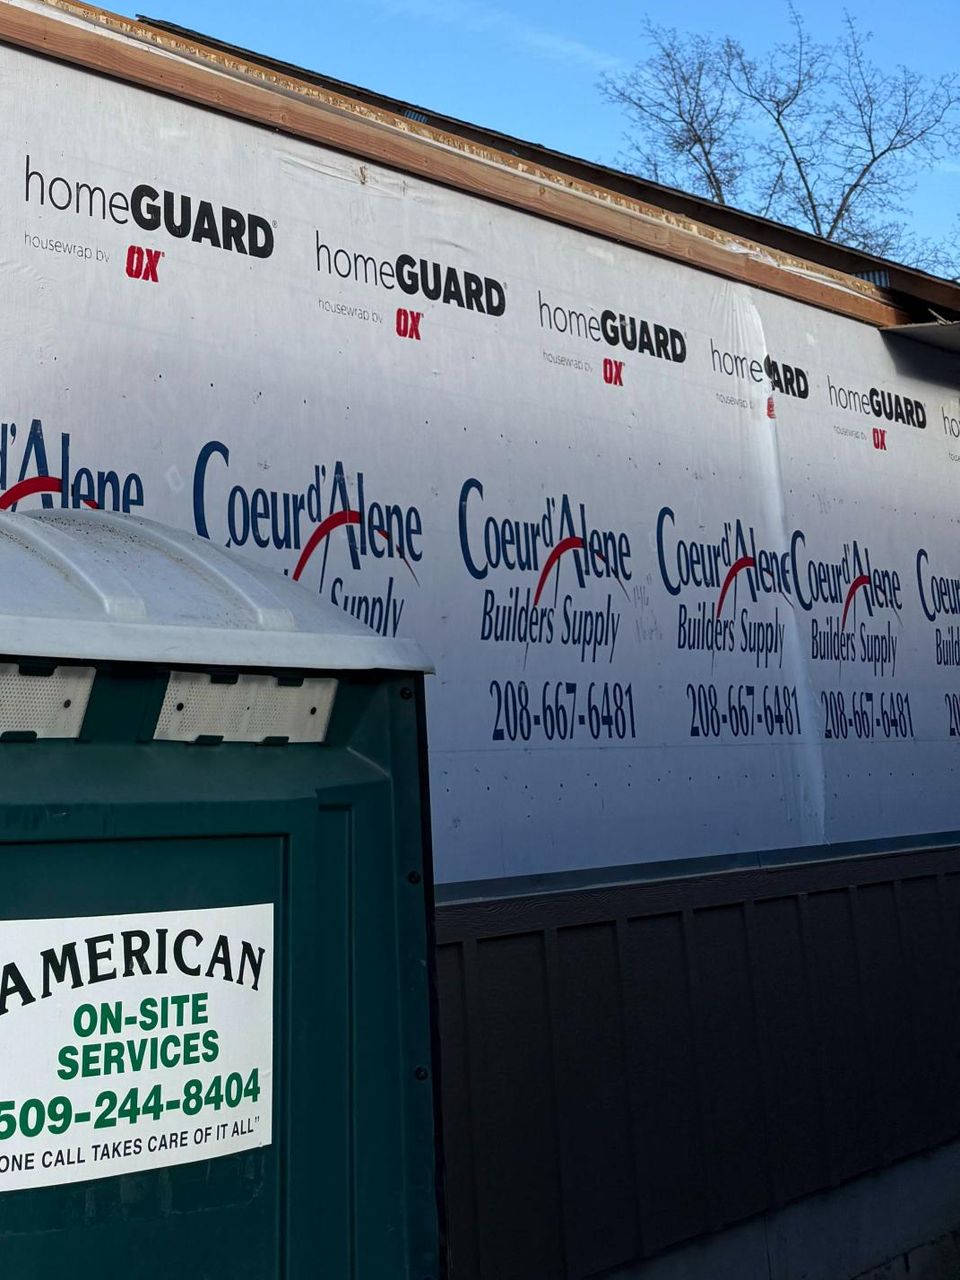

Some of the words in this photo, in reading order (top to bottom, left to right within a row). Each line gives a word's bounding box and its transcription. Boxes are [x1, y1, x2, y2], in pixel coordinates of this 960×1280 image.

[25, 154, 275, 260] homeGUARD
[24, 231, 92, 261] housewrap
[125, 244, 166, 283] OX
[315, 230, 506, 317] homeGUARD
[395, 307, 421, 341] OX
[538, 289, 688, 364] homeGUARD
[602, 358, 624, 387] OX
[710, 338, 809, 400] homeARD
[827, 374, 927, 430] homeGUARD
[872, 427, 887, 451] OX
[458, 477, 541, 580] Coeur
[542, 494, 633, 608] d'Alene
[656, 506, 721, 596] Coeur
[790, 529, 843, 611] Coeur
[842, 540, 903, 629] d'Alene
[480, 587, 556, 646] Builders
[560, 594, 621, 663] Supply
[677, 601, 735, 652] Builders
[741, 606, 785, 669] Supply
[811, 616, 856, 662] Builders
[860, 621, 898, 677] Supply
[935, 625, 960, 666] Build
[490, 679, 637, 742] 208-667-6481
[686, 683, 802, 738] 208-667-6481
[820, 689, 915, 740] 208-667-6481
[72, 992, 209, 1038] ON-SITE
[56, 1029, 220, 1081] SERVICES
[41, 1146, 86, 1168] CALL
[91, 1137, 142, 1162] TAKES
[147, 1130, 189, 1153] CARE
[193, 1126, 212, 1145] OF
[216, 1122, 230, 1140] IT
